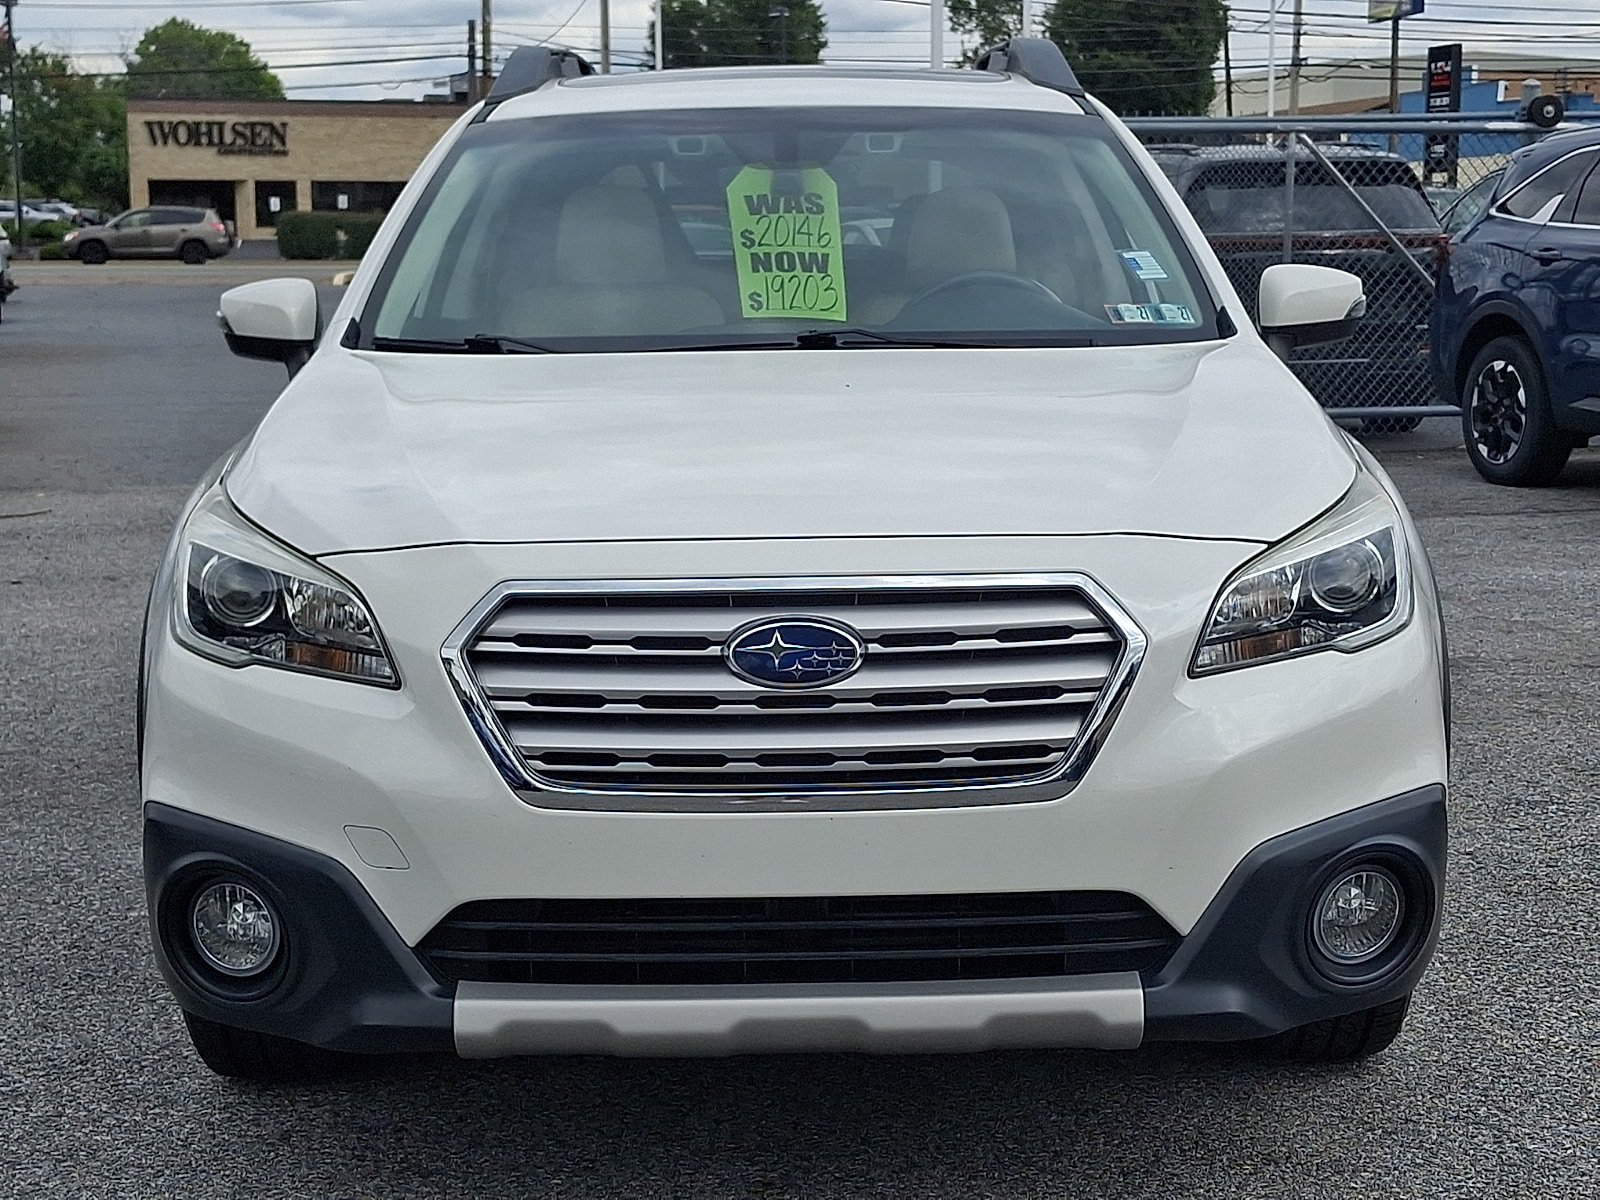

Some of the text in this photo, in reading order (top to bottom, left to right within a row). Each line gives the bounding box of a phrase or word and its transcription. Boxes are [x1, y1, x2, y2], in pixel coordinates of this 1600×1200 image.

[144, 120, 288, 147] WOHLSEN
[743, 192, 825, 216] WAS
[750, 251, 830, 273] NOW
